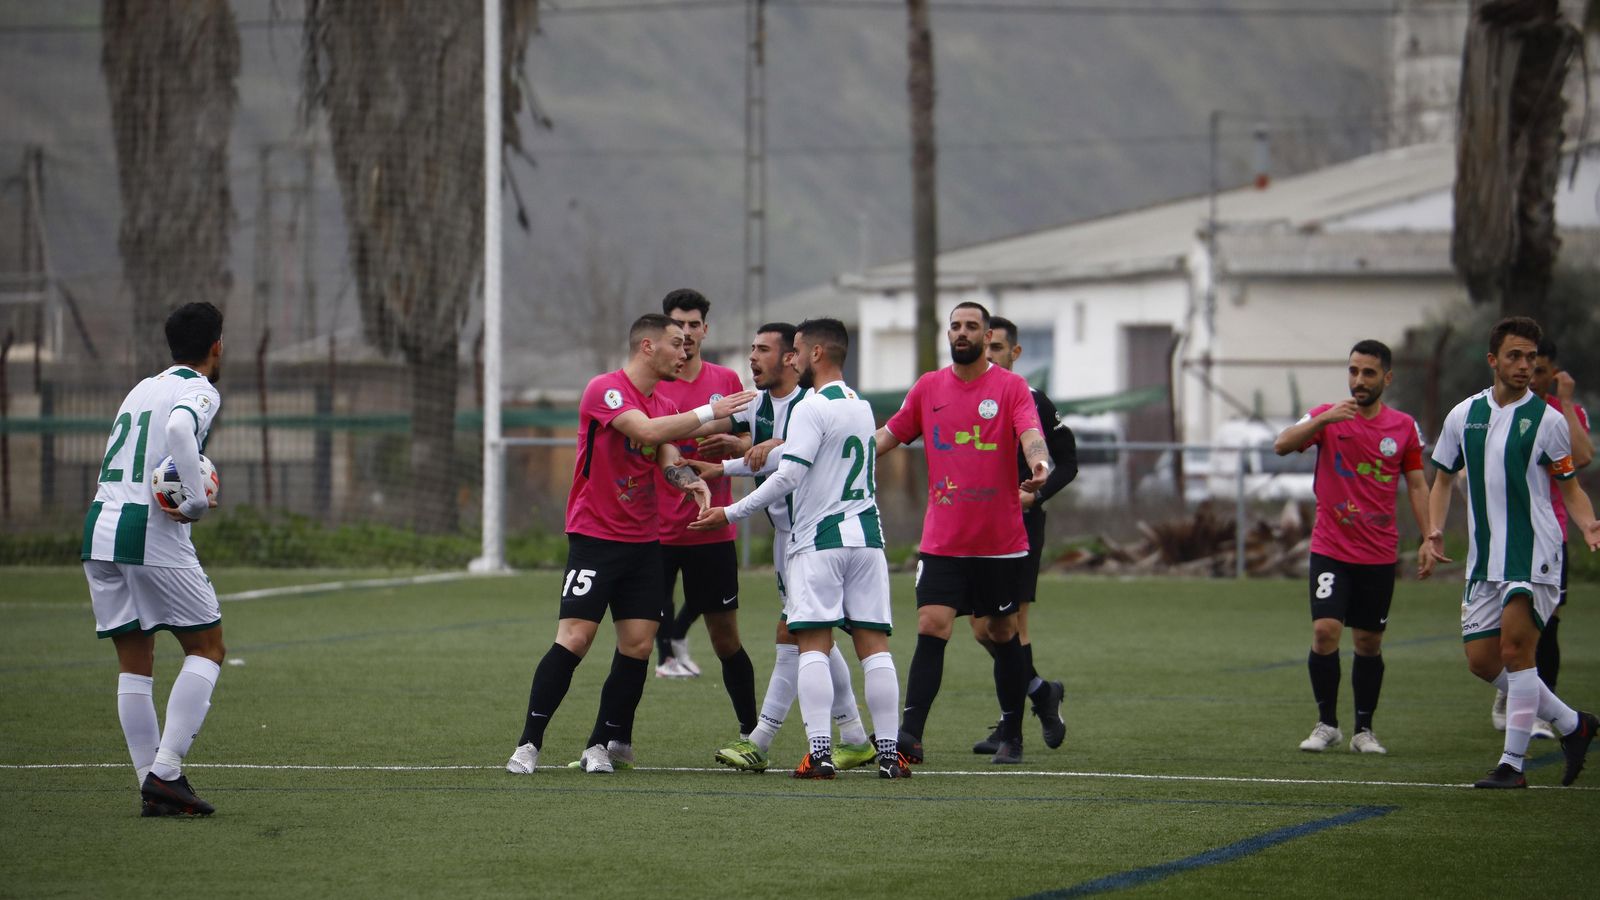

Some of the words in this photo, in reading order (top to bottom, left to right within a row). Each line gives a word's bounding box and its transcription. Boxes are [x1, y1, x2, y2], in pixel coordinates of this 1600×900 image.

[99, 410, 152, 483] 21
[840, 435, 877, 501] 20
[562, 568, 597, 597] 15
[1315, 571, 1336, 600] 8
